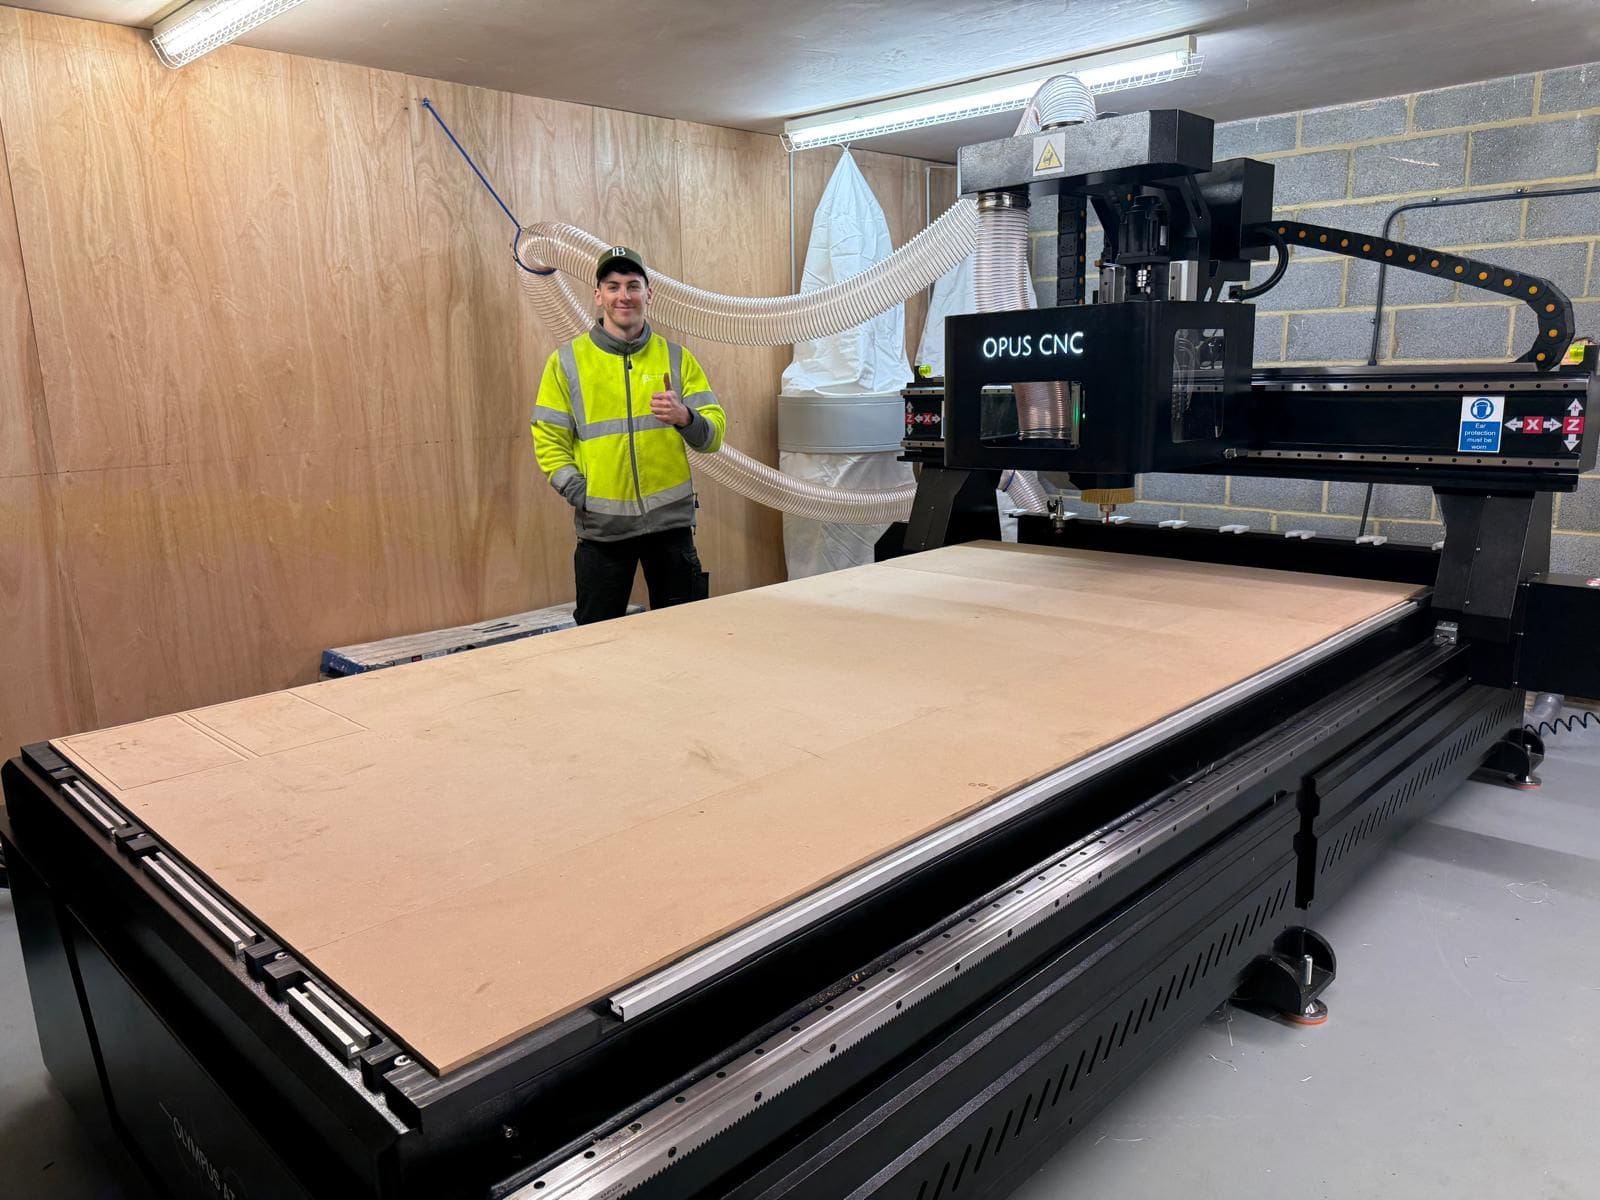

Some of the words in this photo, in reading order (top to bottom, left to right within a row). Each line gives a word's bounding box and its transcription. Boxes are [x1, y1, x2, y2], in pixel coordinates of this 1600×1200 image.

[982, 335, 1032, 358] OPUS
[1039, 331, 1084, 355] CNC
[1526, 418, 1540, 431] X
[1566, 418, 1580, 431] Z
[173, 1116, 222, 1192] OLYMPUS
